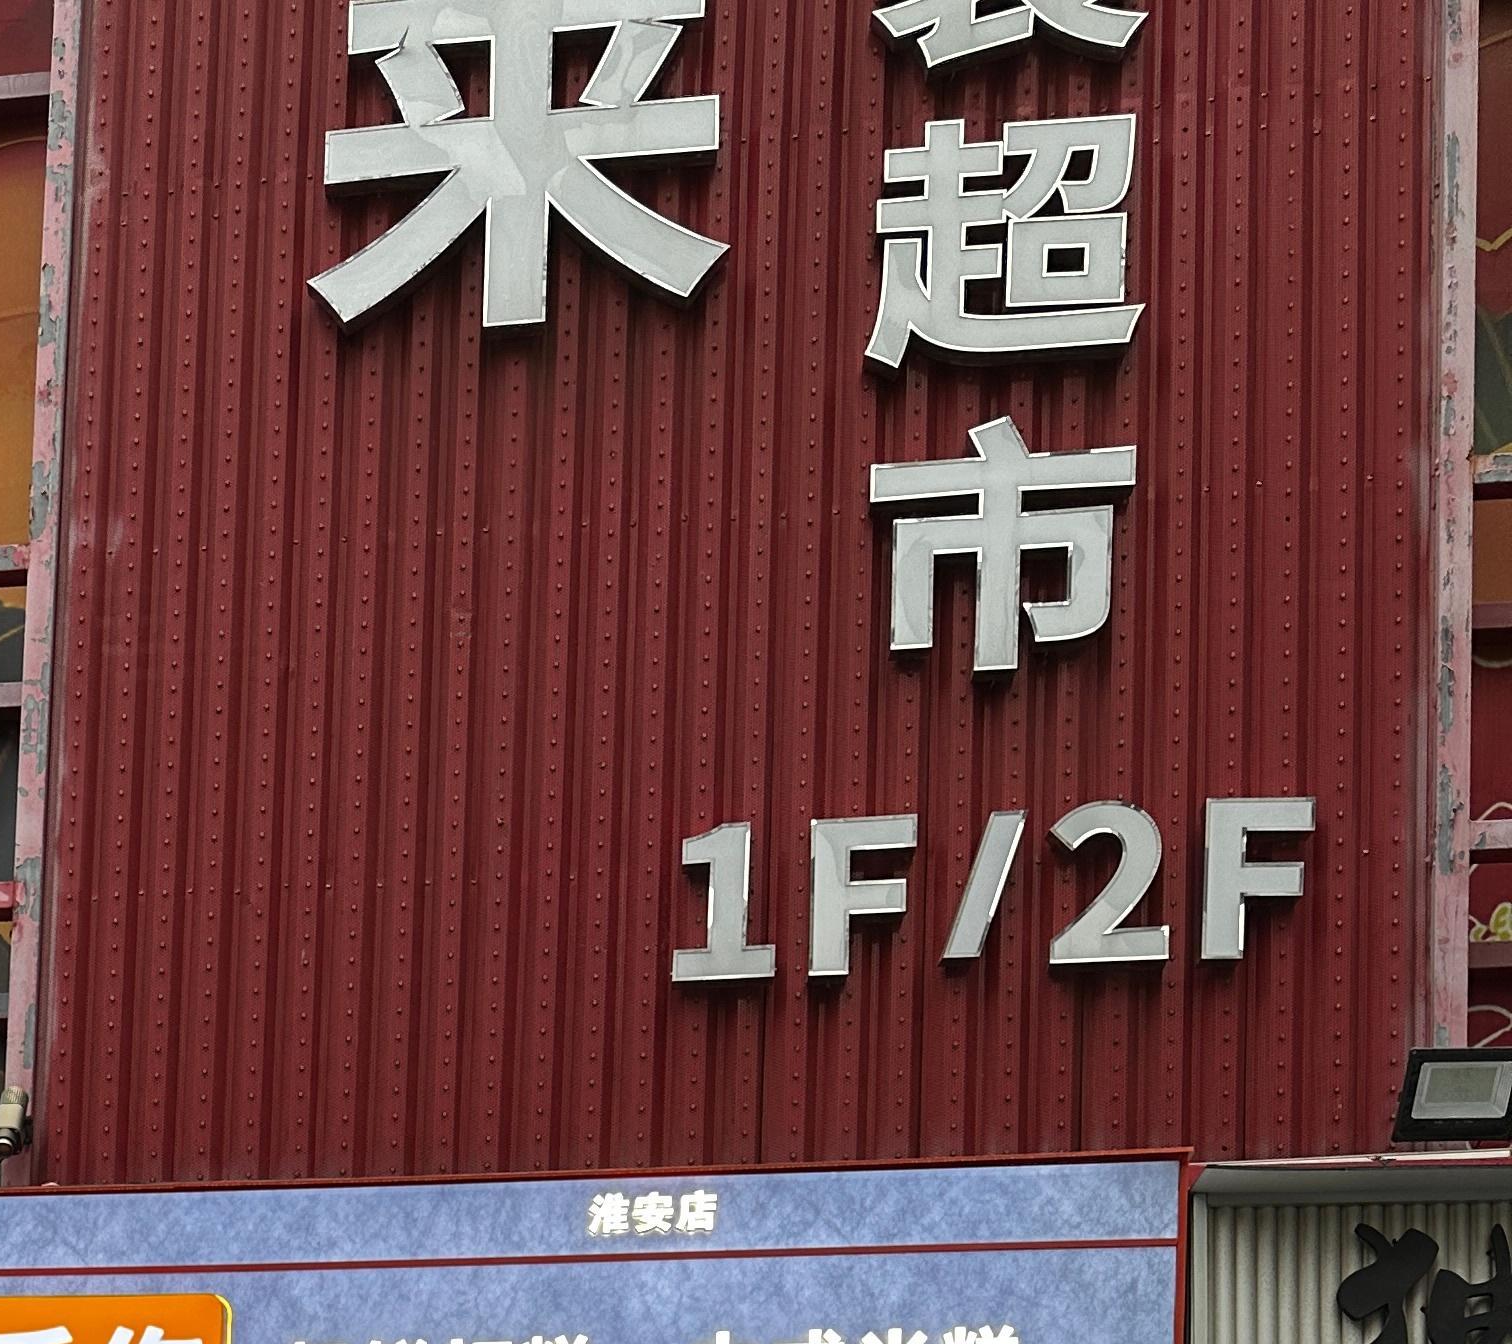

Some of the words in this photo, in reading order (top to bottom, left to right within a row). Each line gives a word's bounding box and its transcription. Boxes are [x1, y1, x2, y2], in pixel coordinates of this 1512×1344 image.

[863, 0, 1148, 672] 超市
[671, 797, 1317, 982] 1F/2F
[587, 1190, 718, 1237] 淮安店
